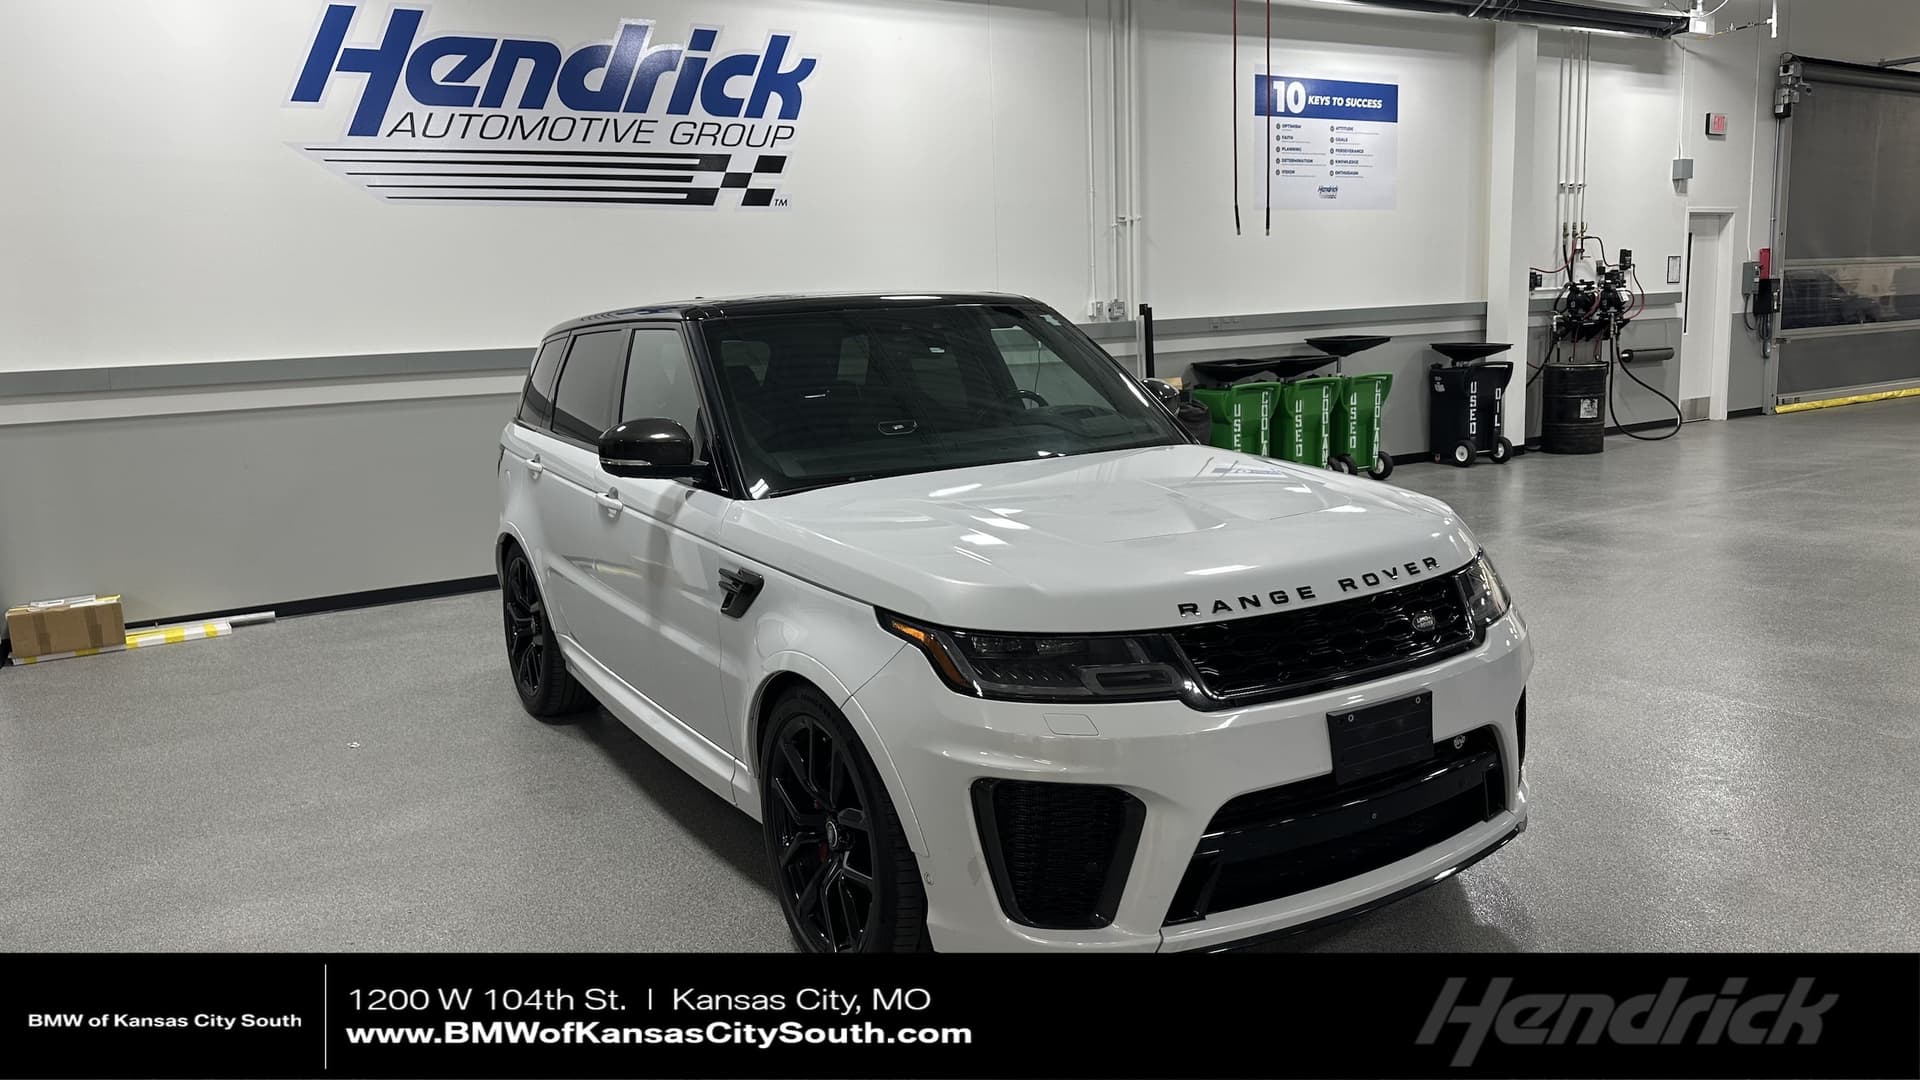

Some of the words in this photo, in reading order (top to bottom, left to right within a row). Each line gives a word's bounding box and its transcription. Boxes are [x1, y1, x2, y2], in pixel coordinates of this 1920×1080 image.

[290, 4, 816, 136] Hendrick
[1273, 80, 1306, 114] 10
[1308, 95, 1330, 106] KEYS
[1332, 96, 1344, 107] TO
[1345, 98, 1383, 109] SUCCESS
[386, 111, 657, 145] AUTOMOTIVE
[669, 121, 795, 148] GROUP
[1295, 400, 1303, 457] USED
[1372, 380, 1381, 468] COOLANT
[1469, 381, 1477, 434] USED
[1177, 585, 1316, 617] RANGE
[1337, 556, 1440, 592] ROVER
